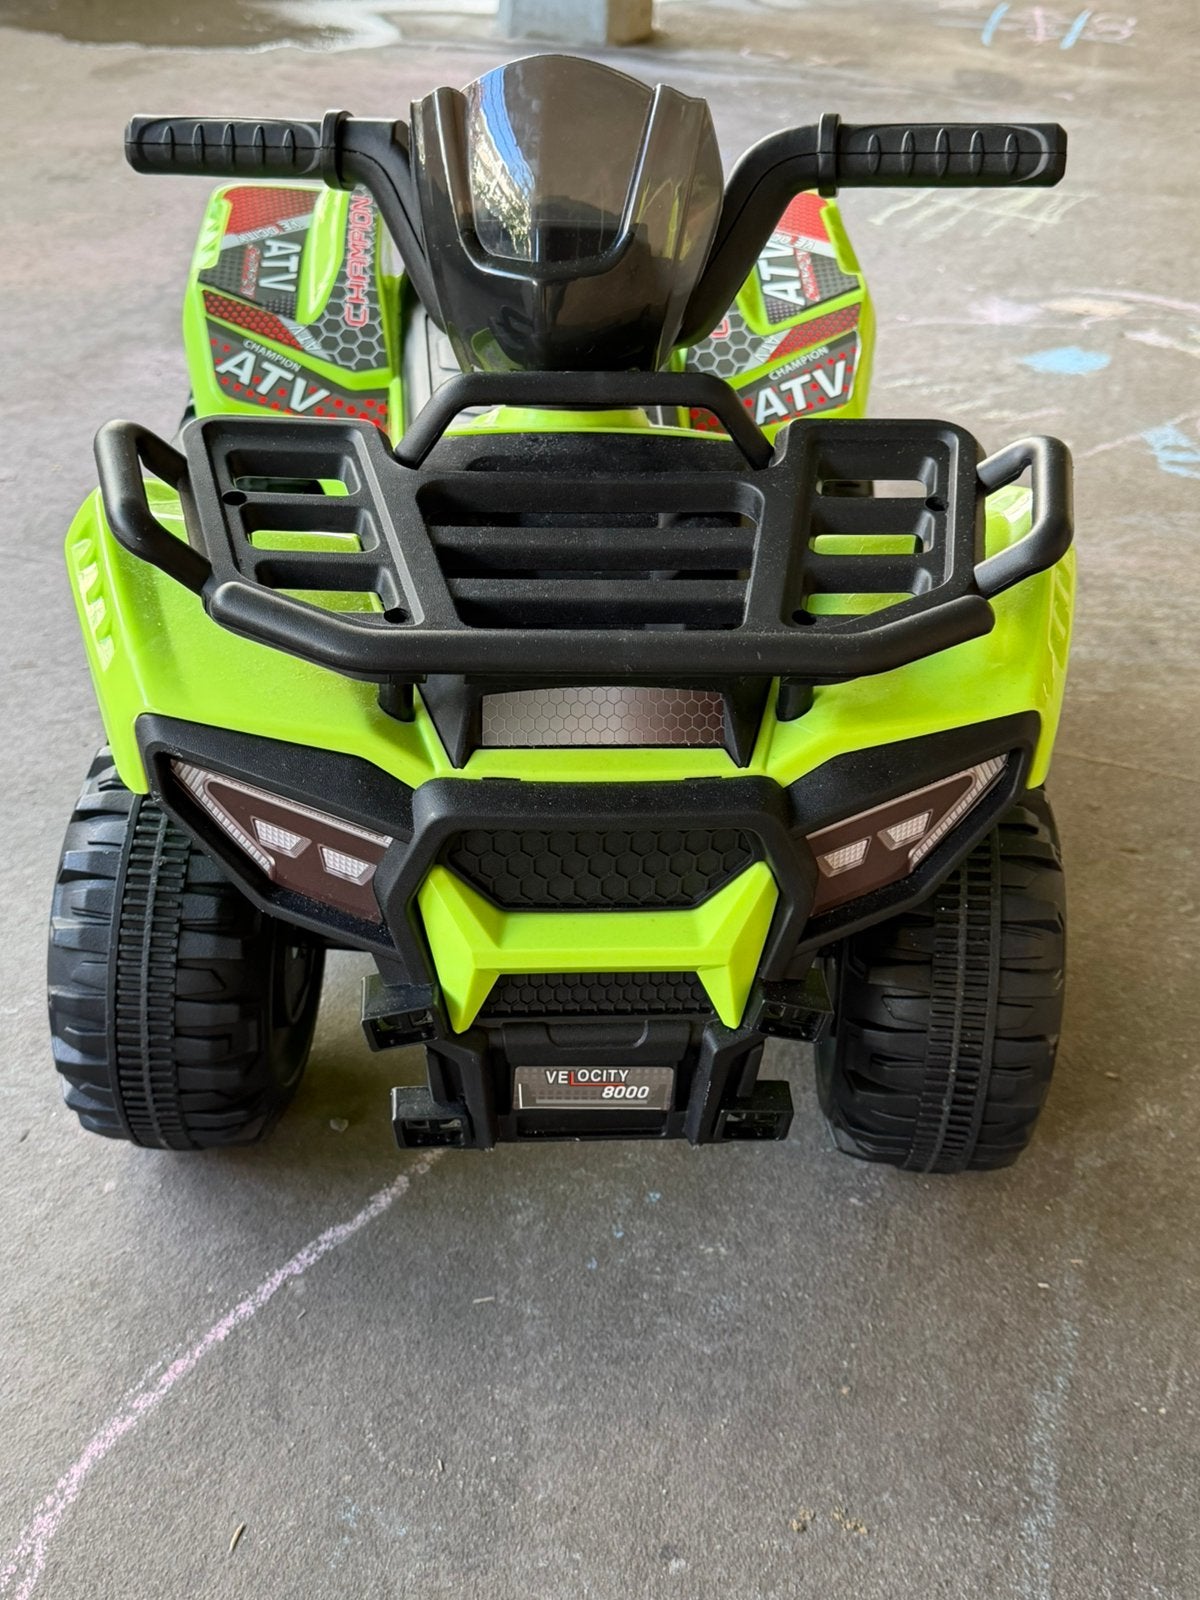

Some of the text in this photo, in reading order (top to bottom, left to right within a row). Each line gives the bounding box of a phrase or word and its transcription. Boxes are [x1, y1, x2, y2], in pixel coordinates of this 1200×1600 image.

[258, 239, 302, 292] ATV
[345, 195, 372, 327] CHAMPION
[758, 242, 805, 306] ATV
[216, 351, 331, 413] ATV
[242, 339, 302, 372] CHAMPION
[768, 346, 829, 381] CHAMPION
[755, 360, 847, 425] ATV
[545, 1069, 629, 1086] VELOCITY
[602, 1086, 650, 1099] 8000
